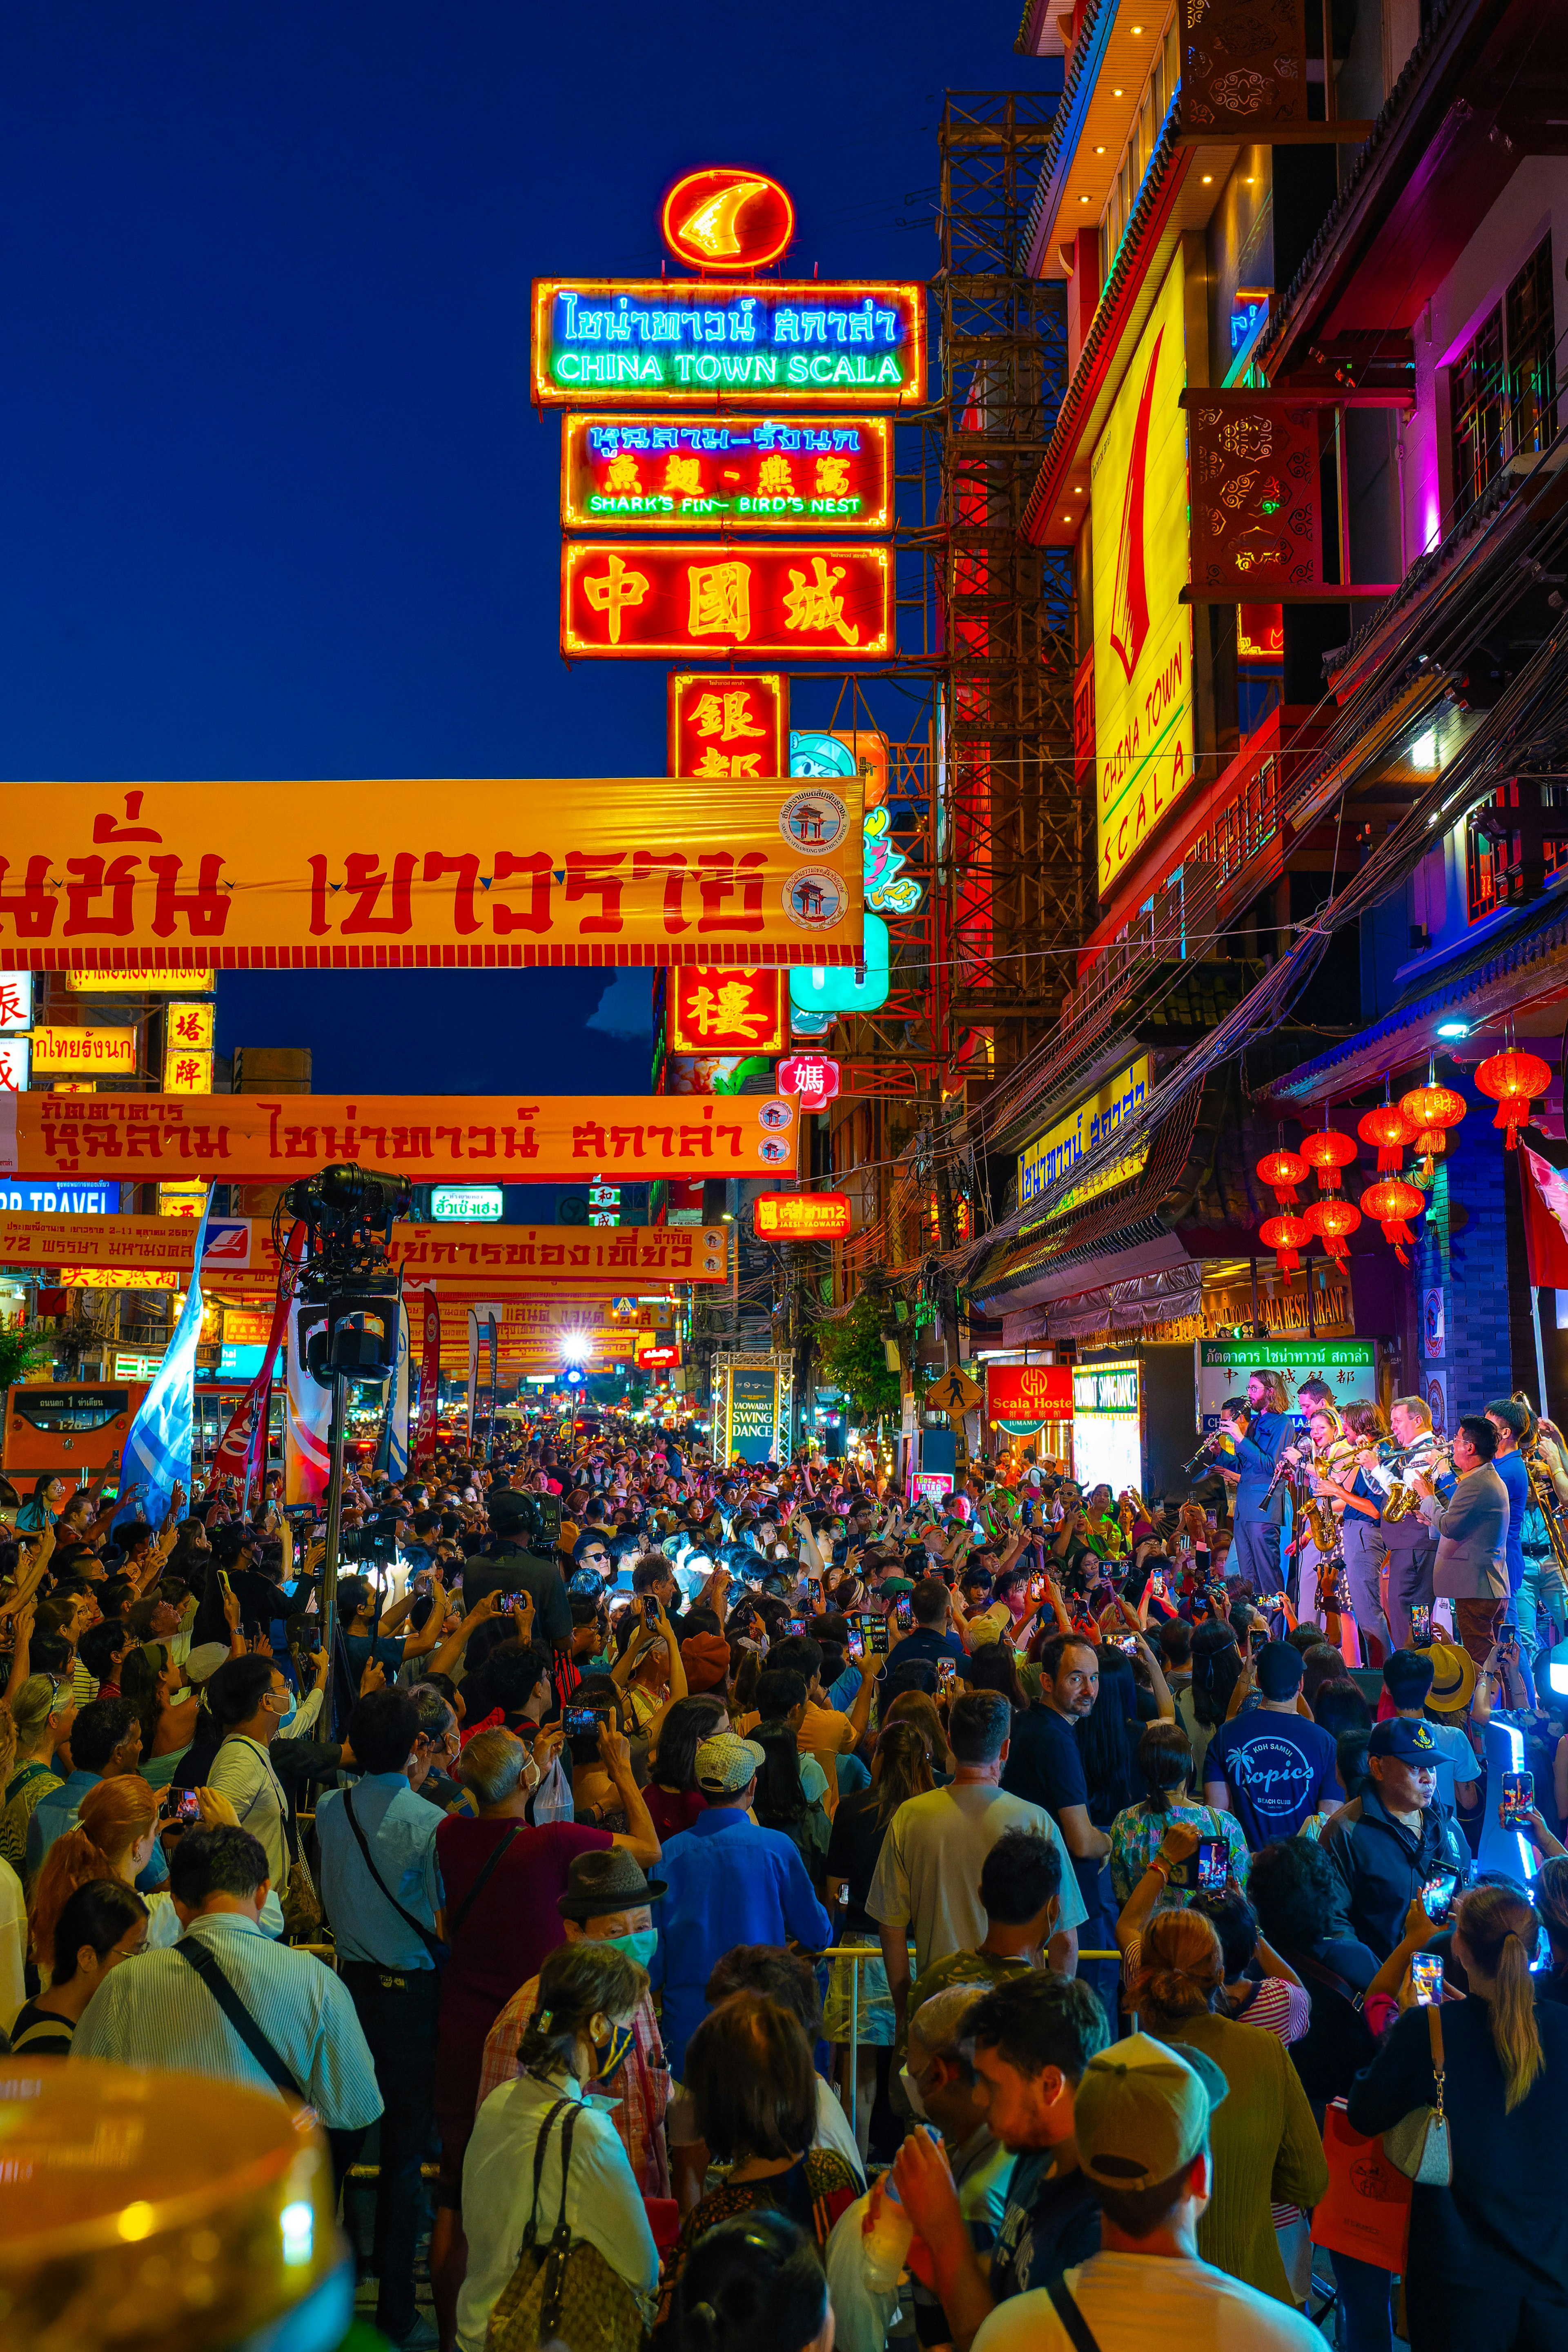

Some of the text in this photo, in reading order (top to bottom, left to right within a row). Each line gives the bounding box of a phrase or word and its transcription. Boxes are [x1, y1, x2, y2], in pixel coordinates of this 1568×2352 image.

[559, 293, 896, 341] ไชน่าทาวน์ สกาล่า
[557, 354, 902, 382] CHINA TOWN SCALA
[590, 495, 674, 512] SHARK'S
[740, 497, 804, 512] BIRD'S
[811, 499, 860, 513] NEST
[584, 554, 859, 645] 中國城
[1103, 641, 1182, 803] CHINA TOWN
[1104, 740, 1184, 882] SCALA
[837, 823, 847, 841] OFFICE
[307, 850, 769, 935] เยาวราช
[794, 1063, 824, 1094] 媽
[41, 1093, 184, 1121] ภัตตาคาร
[41, 1102, 744, 1171] หูฉลาม ไชน่าทาวน์ สกาล่า
[4, 1236, 193, 1258] 72 พรรษา มหามงคล
[653, 1228, 693, 1245] จำกัด
[1285, 1287, 1345, 1330] RESTURANT
[1206, 1347, 1369, 1363] ภัตตาคาร ไชน่าทาวน์ สกาล่า
[68, 1396, 73, 1407] 1
[734, 1402, 773, 1410] YAOWARAT
[993, 1398, 1030, 1409] Scala
[733, 1412, 773, 1423] SWING
[732, 1424, 773, 1437] DANCE
[1253, 1743, 1293, 1757] KOH SAMUI
